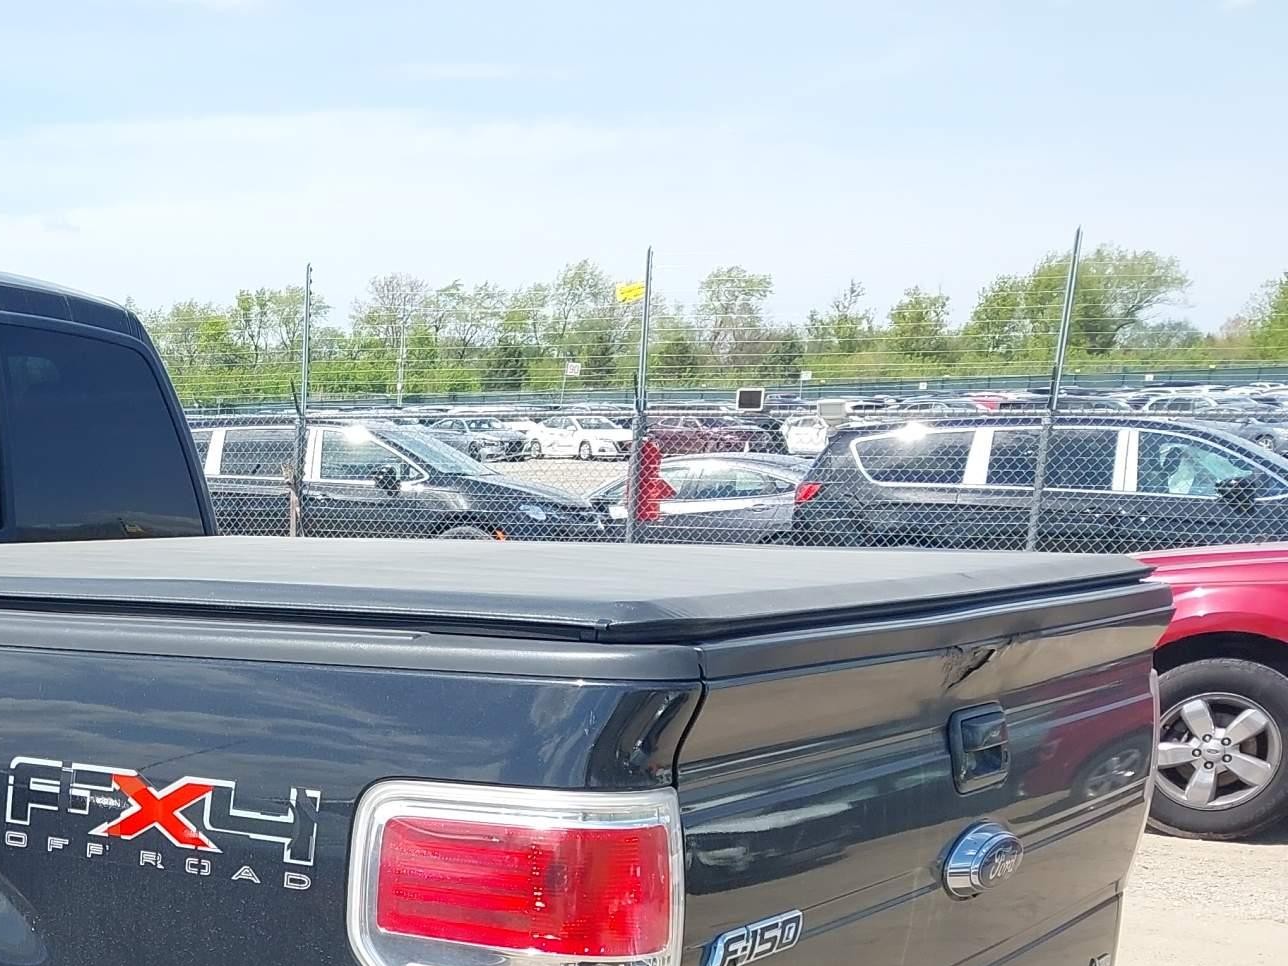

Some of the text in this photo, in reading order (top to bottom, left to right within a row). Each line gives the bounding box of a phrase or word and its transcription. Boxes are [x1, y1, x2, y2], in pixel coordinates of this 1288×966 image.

[5, 756, 321, 867] FX4
[5, 830, 312, 890] OFF ROAD
[989, 846, 1019, 880] Ford
